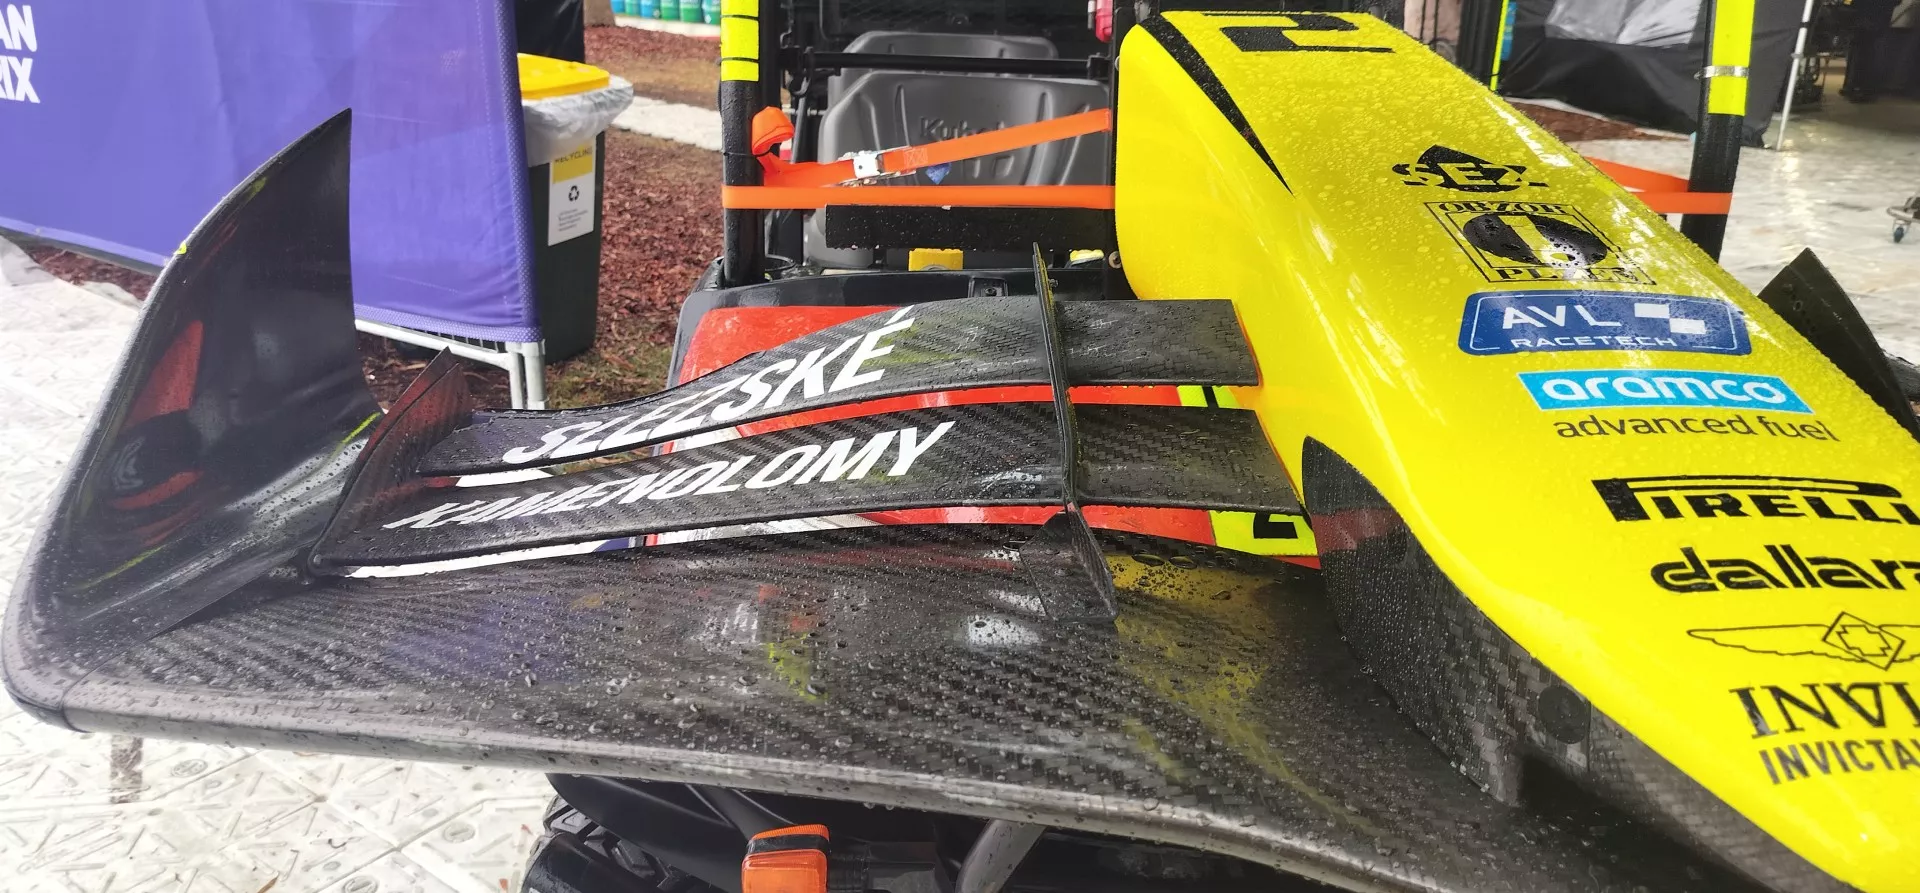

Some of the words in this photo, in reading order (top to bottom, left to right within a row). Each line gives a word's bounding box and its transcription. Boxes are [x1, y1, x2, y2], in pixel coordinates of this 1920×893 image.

[1202, 12, 1397, 53] 2
[1438, 202, 1568, 215] OBZOR
[1502, 303, 1622, 330] AVL
[1511, 334, 1678, 349] RACETECH
[502, 304, 915, 465] SLEZSKÉ
[1541, 375, 1787, 404] aramco
[1553, 414, 1758, 438] advanced
[1756, 415, 1842, 442] fuel
[384, 421, 955, 530] KAMENOLOMY
[1590, 475, 1920, 526] PIRELLI
